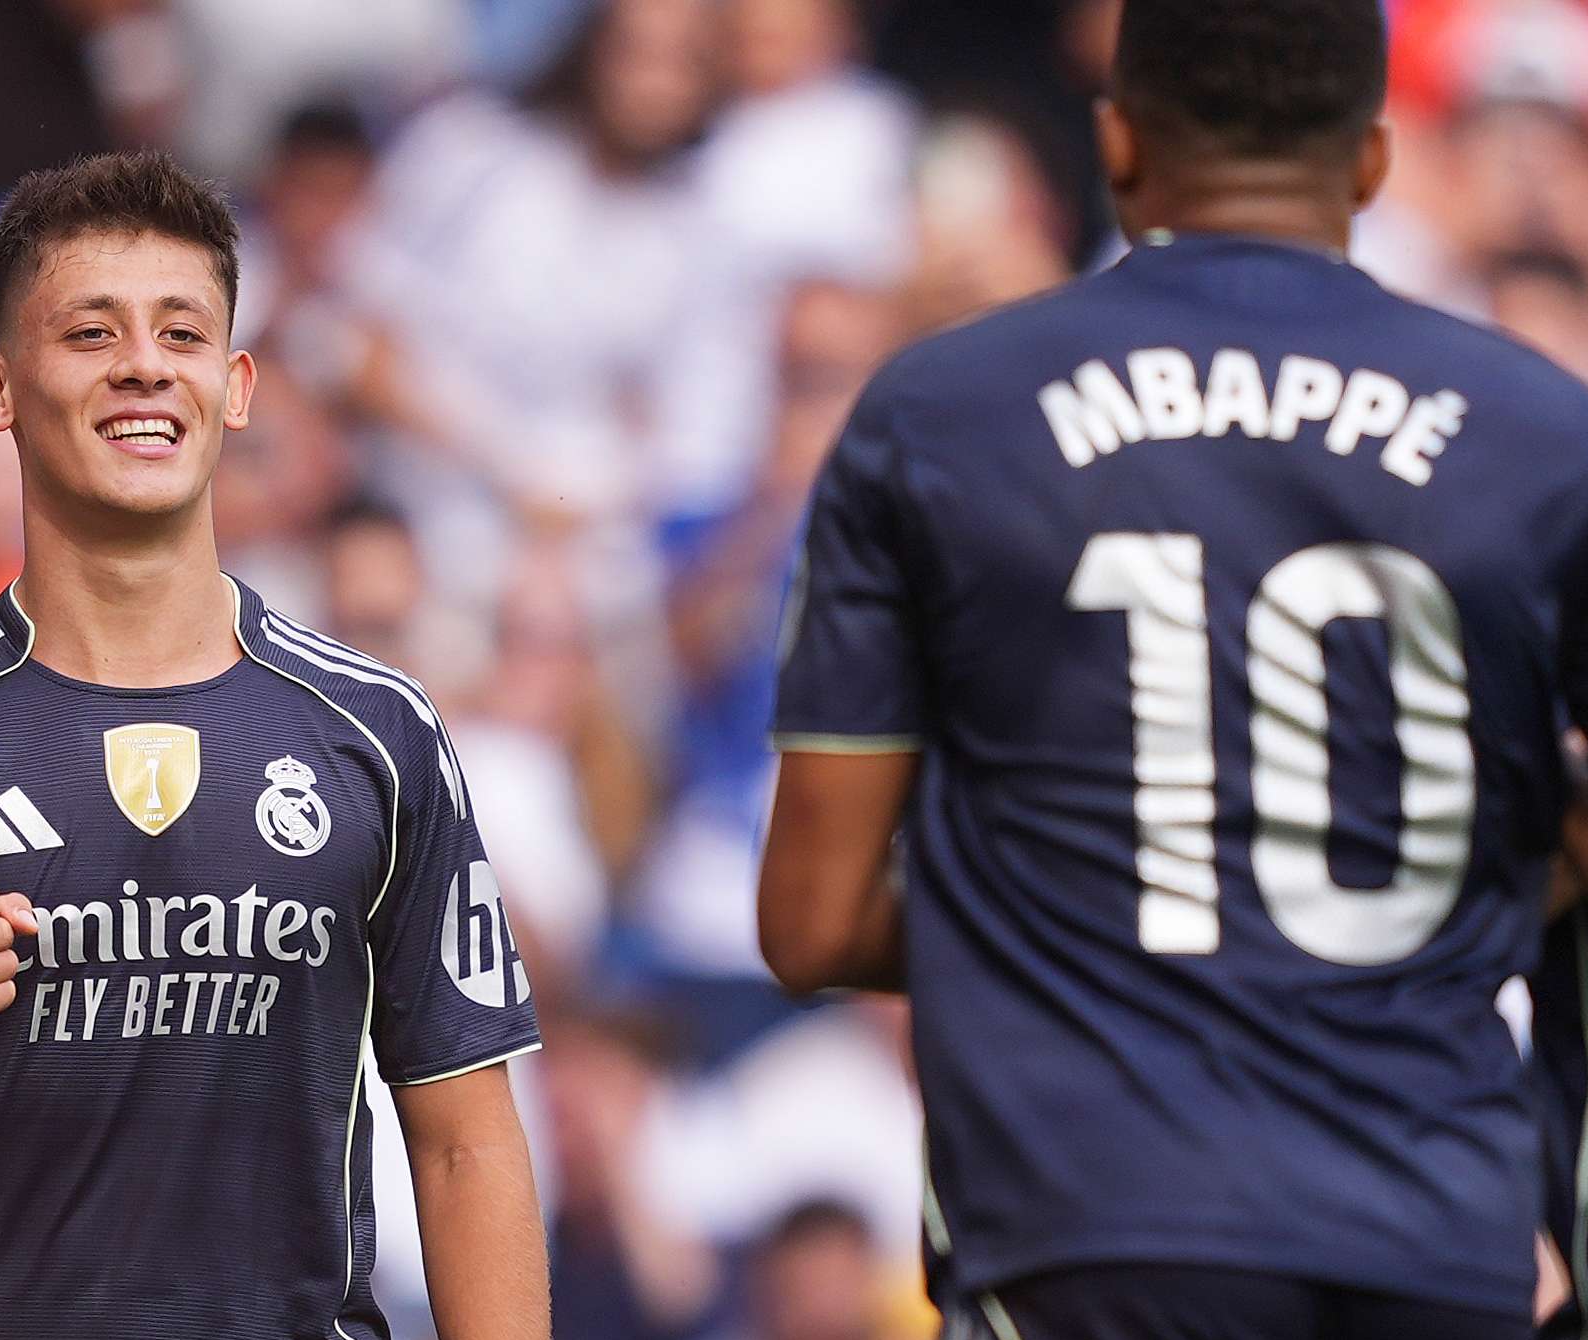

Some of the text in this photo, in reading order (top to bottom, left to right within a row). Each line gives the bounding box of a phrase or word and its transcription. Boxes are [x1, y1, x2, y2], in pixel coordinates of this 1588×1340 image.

[1037, 346, 1468, 486] MBAPPÉ
[1064, 531, 1477, 967] 10
[143, 812, 164, 822] FIFA
[16, 879, 336, 973] mirates
[29, 972, 281, 1043] FLY BETTER
